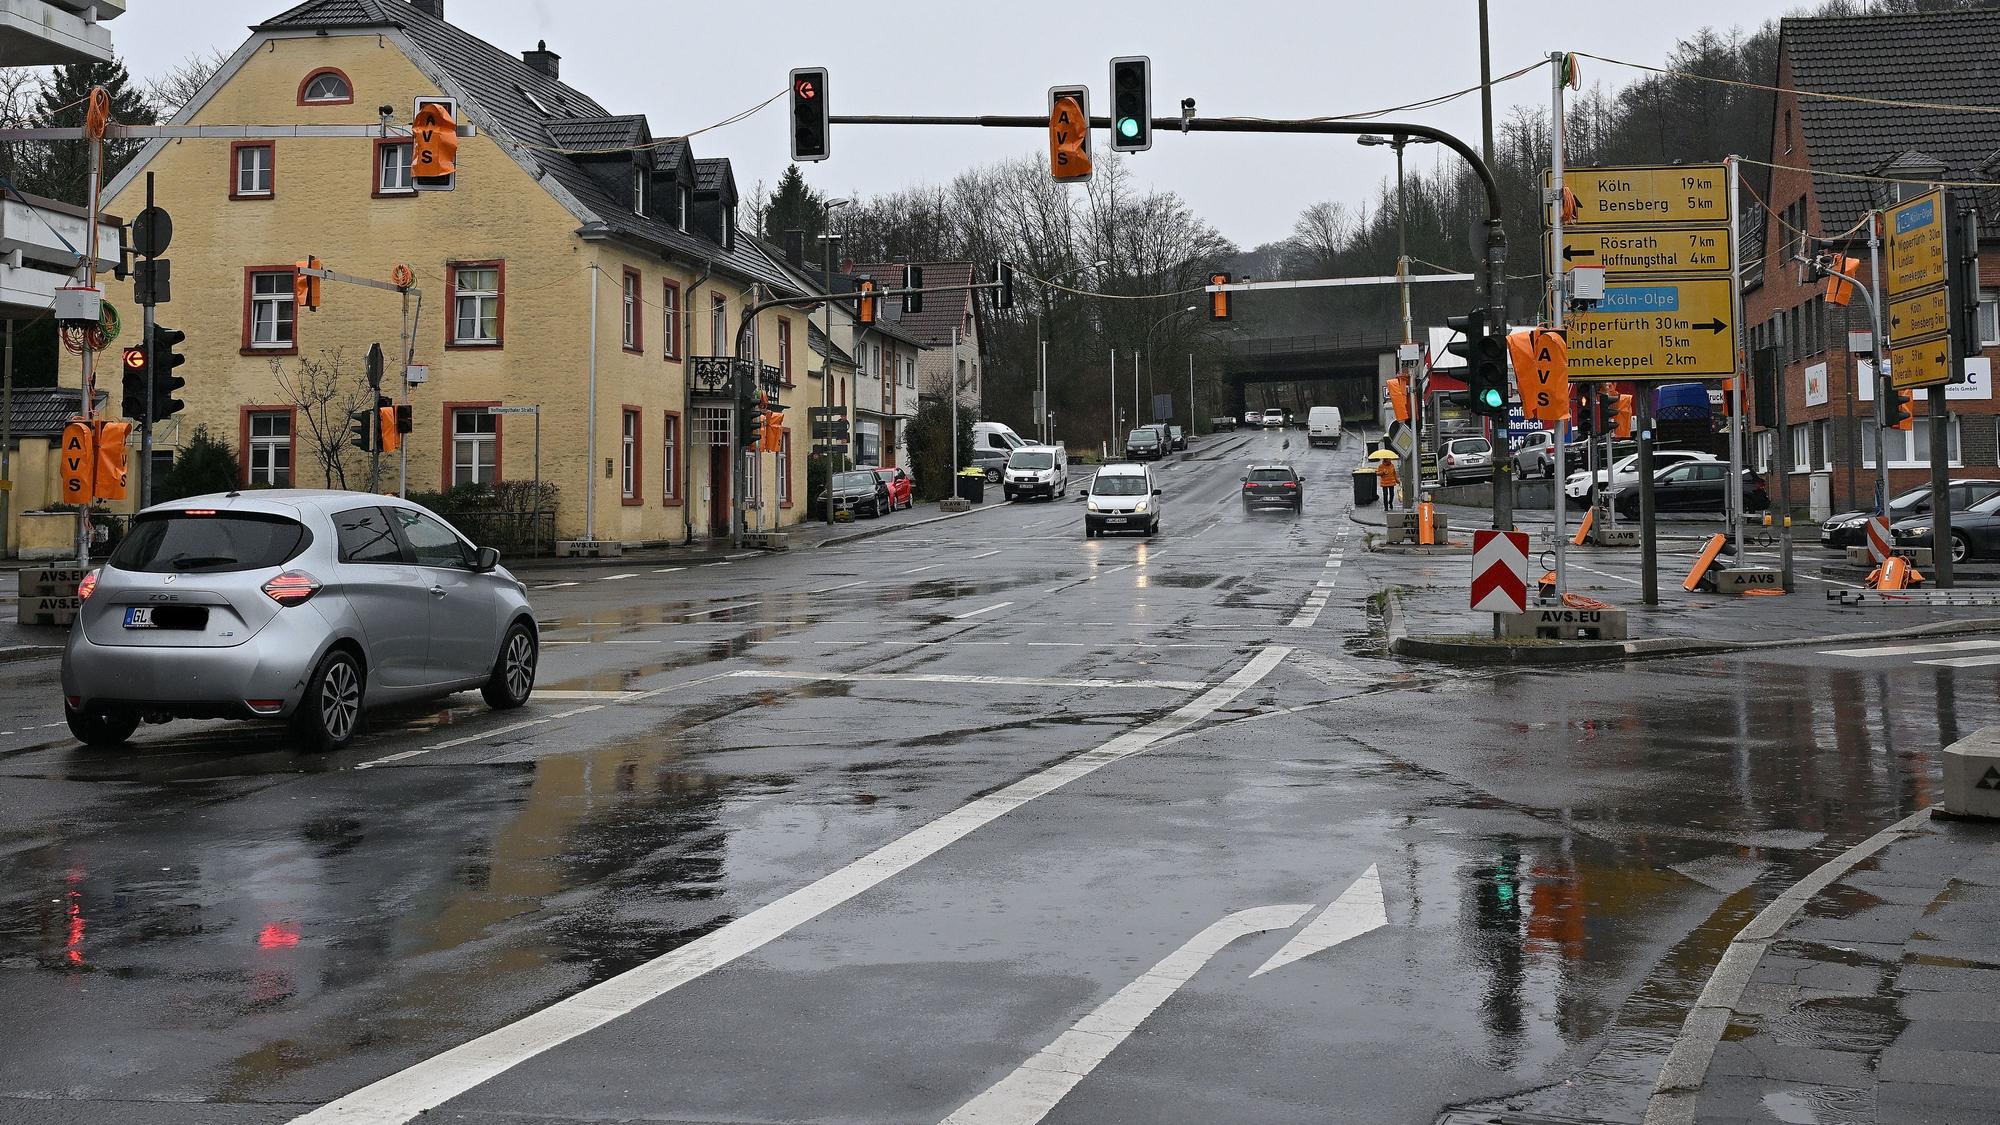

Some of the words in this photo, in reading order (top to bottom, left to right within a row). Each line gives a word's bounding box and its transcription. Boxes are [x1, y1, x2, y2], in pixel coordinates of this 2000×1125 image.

[421, 114, 436, 164] AVS
[1057, 111, 1070, 165] AVS
[1598, 180, 1631, 192] Köln
[1681, 177, 1695, 190] 19
[1697, 178, 1712, 190] km
[1599, 199, 1669, 213] Bensberg
[1688, 197, 1695, 209] 5
[1698, 197, 1713, 209] km
[1600, 236, 1657, 249] Rösrath
[1690, 235, 1697, 247] 7
[1699, 236, 1715, 247] km
[1602, 252, 1678, 268] Hoffnungsthal
[1690, 252, 1698, 264] 4
[1700, 252, 1715, 264] km
[1607, 293, 1674, 307] Köln-Olpe
[1655, 317, 1672, 330] 30
[1674, 317, 1689, 330] km
[1658, 335, 1673, 348] 15
[1675, 336, 1690, 347] km
[1567, 353, 1654, 369] mmekeppel
[1665, 353, 1673, 365] 2
[1676, 353, 1697, 365] km
[1537, 347, 1551, 406] AVS
[68, 437, 81, 492] AVS
[1748, 574, 1775, 584] AVS
[1541, 610, 1600, 622] AVS.EU
